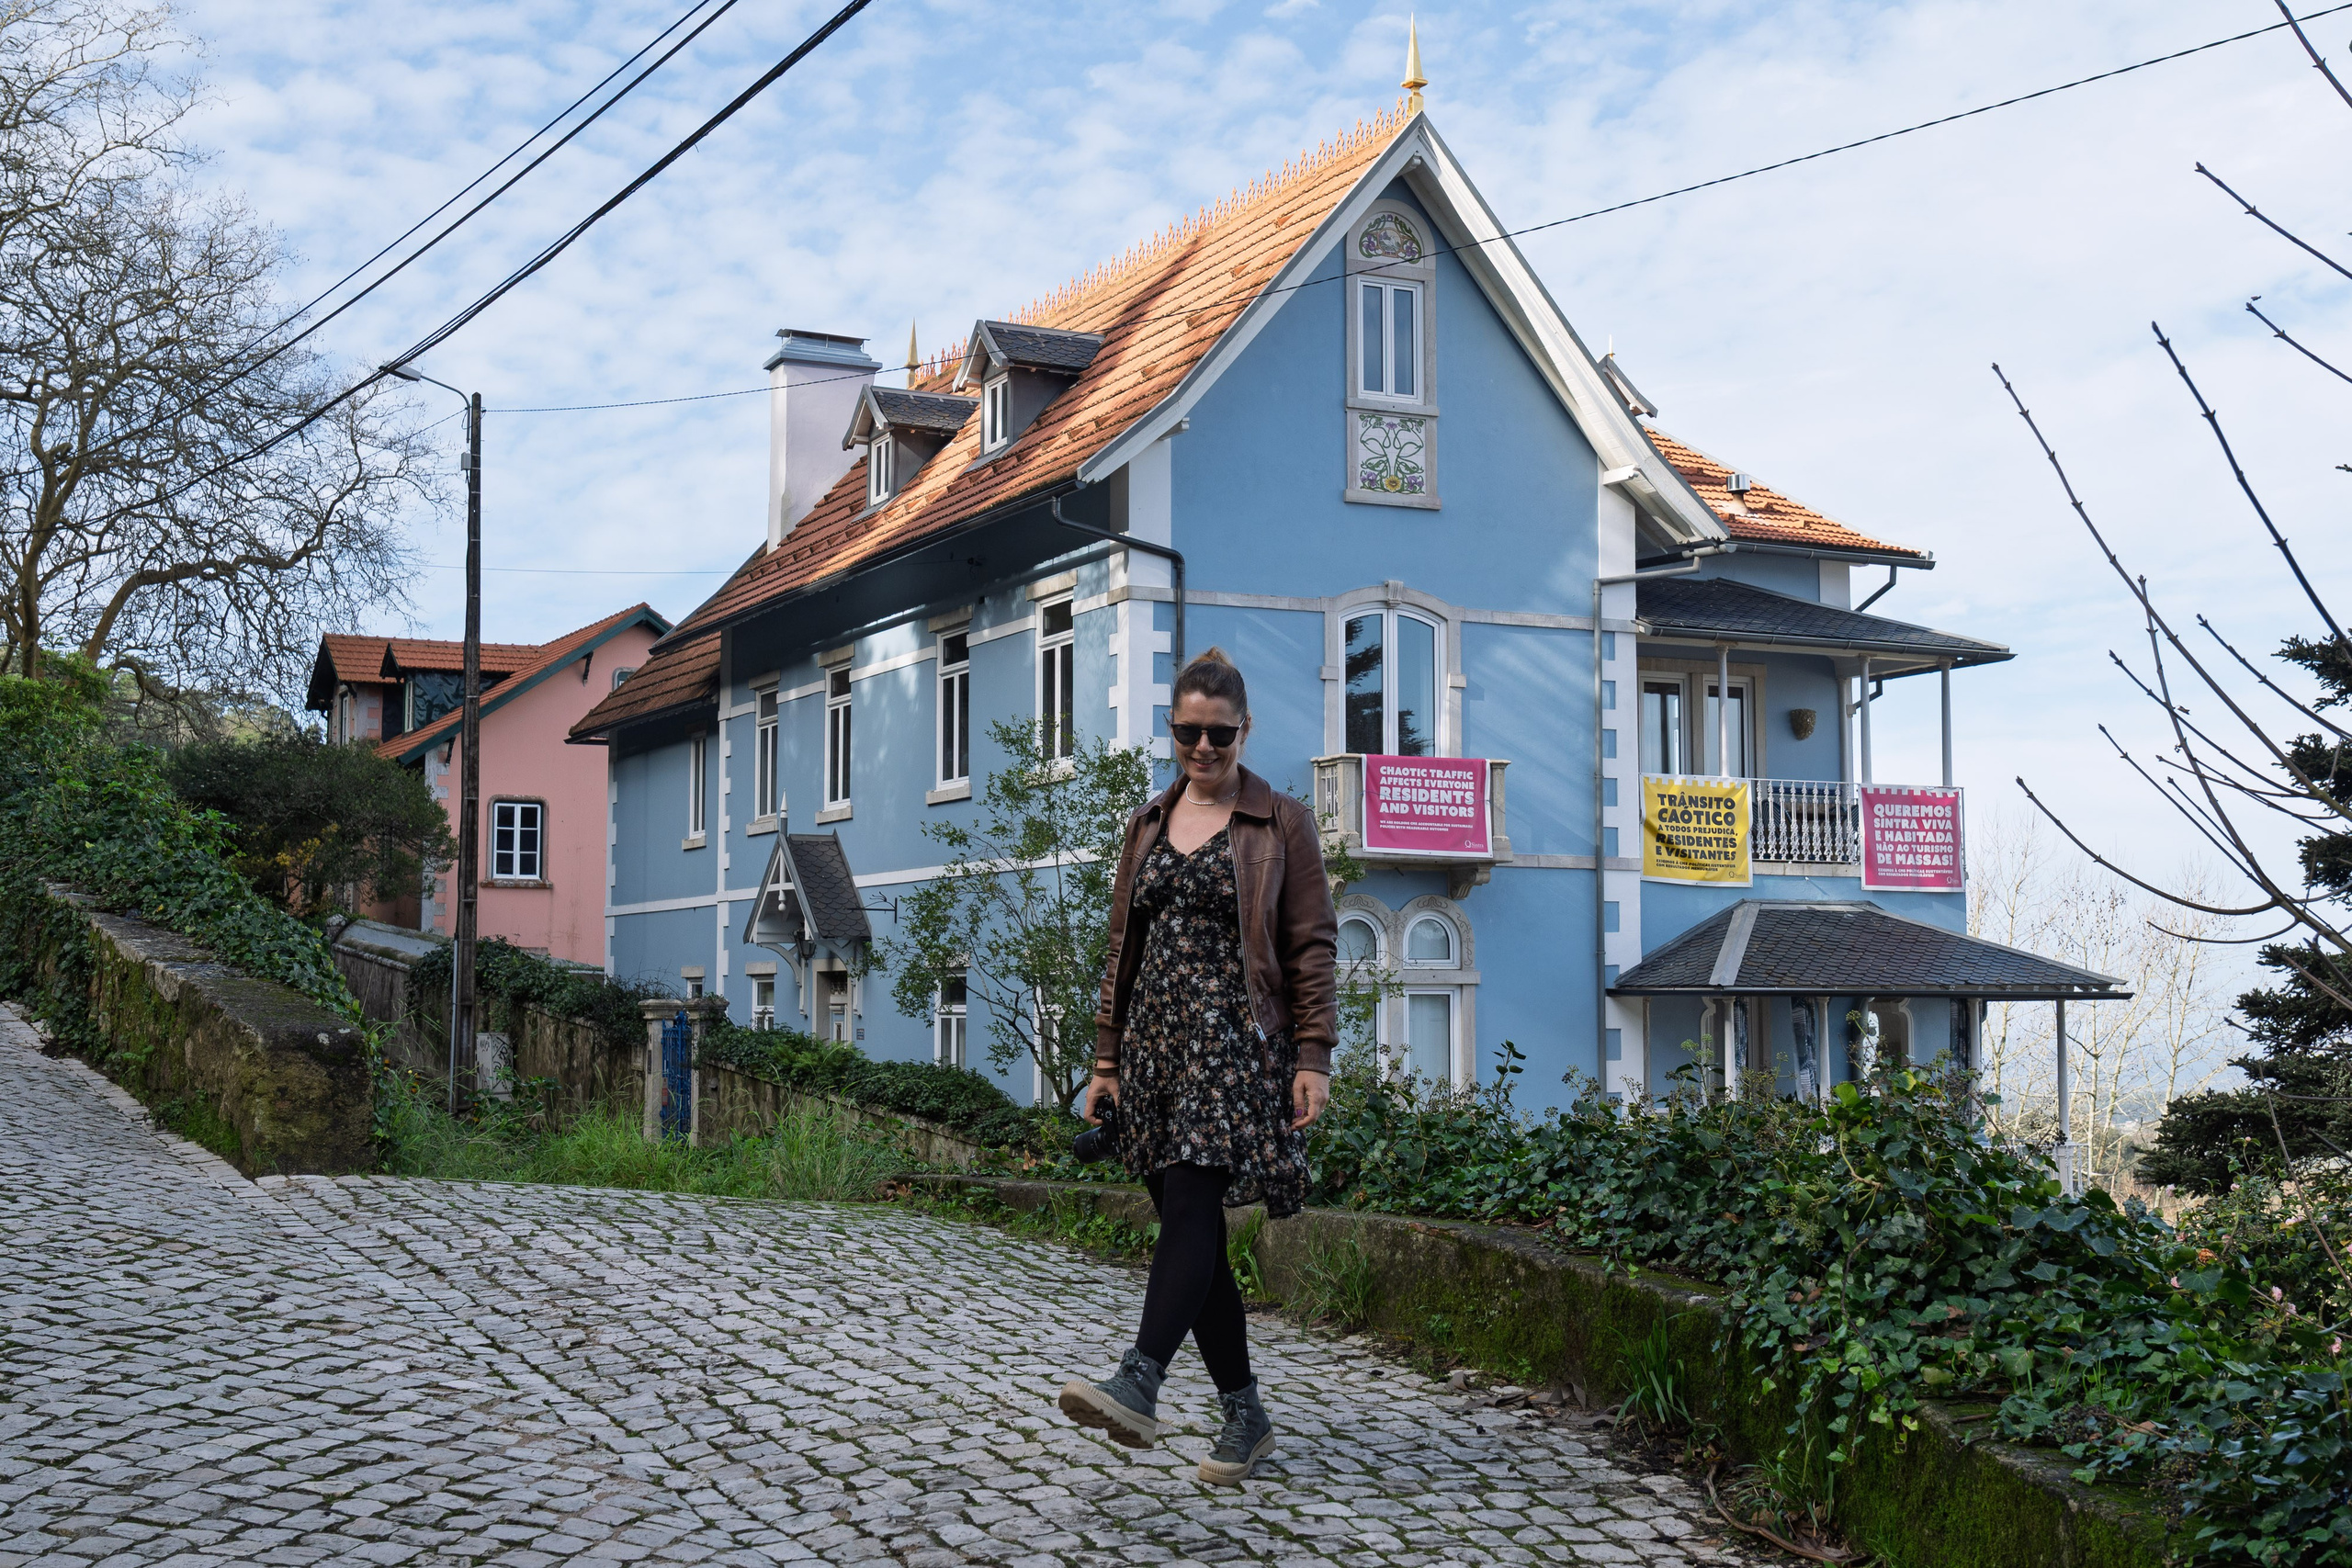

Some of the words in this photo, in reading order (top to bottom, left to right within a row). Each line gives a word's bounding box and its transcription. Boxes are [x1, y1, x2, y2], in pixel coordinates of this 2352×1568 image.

[1380, 766, 1427, 777] CHAOTIC
[1430, 769, 1474, 780] TRAFFIC
[1380, 776, 1422, 787] AFFECTS
[1424, 779, 1475, 790] EVERYONE
[1380, 786, 1475, 805] RESIDENTS
[1657, 792, 1736, 809] TRÂNSITO
[1379, 802, 1409, 814] AND
[1412, 804, 1475, 818] VISITORS
[1657, 806, 1736, 826] CAÓTICO
[1873, 804, 1952, 818] QUEREMOS
[1665, 825, 1691, 833] TODOS
[1693, 827, 1738, 836] PREJUDICA,
[1873, 818, 1918, 829] SINTRA
[1921, 819, 1953, 830] VIVA
[1656, 833, 1737, 849] RESIDENTES
[1875, 830, 1882, 841] E
[1884, 830, 1954, 843] HABITADA
[1656, 845, 1662, 856] E
[1665, 846, 1736, 861] VISITANTES
[1876, 841, 1894, 852] NÃO
[1896, 844, 1909, 852] AO
[1911, 844, 1953, 853] TURISMO
[1877, 852, 1893, 864] DE
[1894, 853, 1953, 866] MASSAS!
